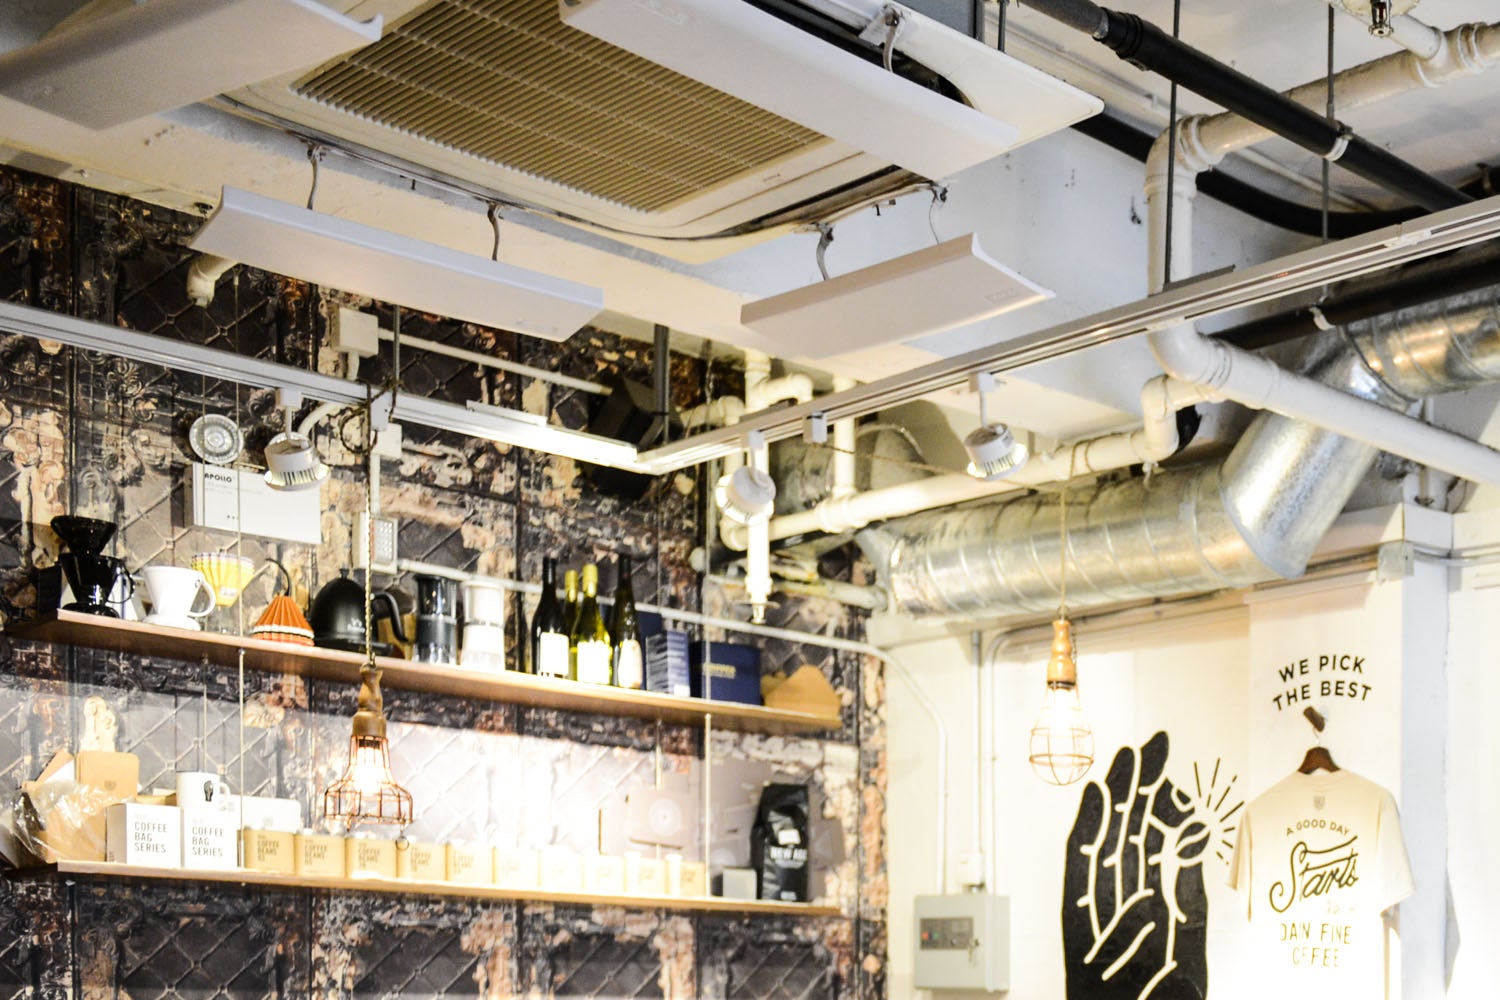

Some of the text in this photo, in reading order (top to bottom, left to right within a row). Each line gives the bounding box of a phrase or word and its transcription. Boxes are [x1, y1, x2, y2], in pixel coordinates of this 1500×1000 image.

[204, 472, 232, 482] APOLLO
[1278, 654, 1366, 683] WE PICK
[1272, 680, 1373, 712] THE BEST
[134, 821, 168, 833] COFFEE
[191, 826, 224, 837] COFFEE
[1286, 819, 1349, 836] A GOOD DAY
[134, 832, 153, 842] BAG
[191, 837, 210, 846] BAG
[134, 842, 167, 853] SERIES
[191, 847, 224, 857] SERIES
